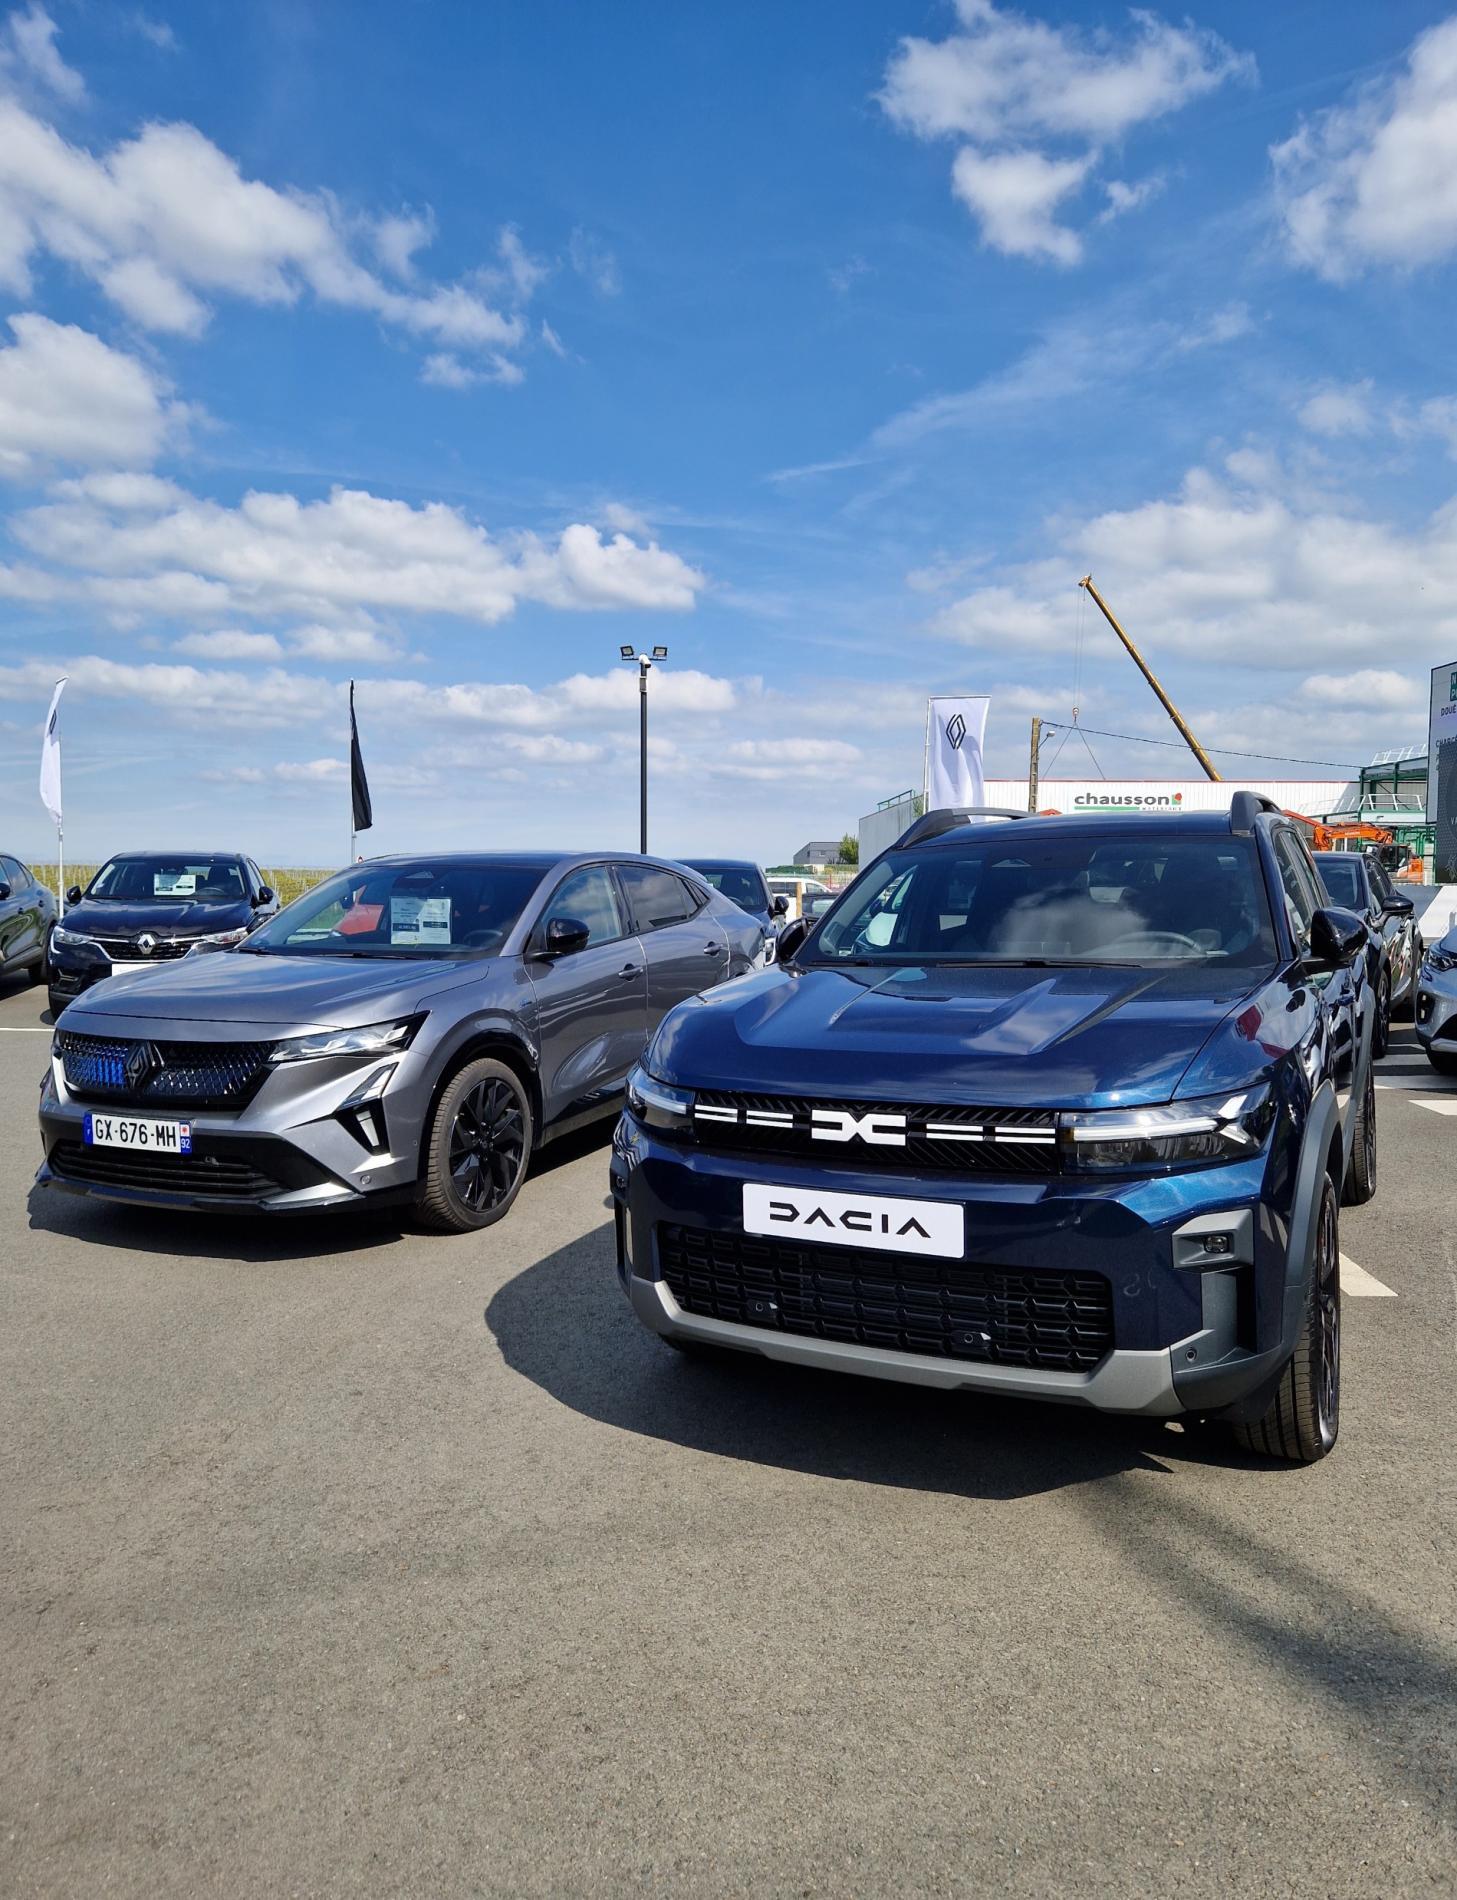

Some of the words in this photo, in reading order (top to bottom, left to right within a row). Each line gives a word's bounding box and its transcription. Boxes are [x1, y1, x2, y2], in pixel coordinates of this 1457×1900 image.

[1074, 792, 1170, 806] chausson
[95, 1118, 177, 1148] GX-676-MH
[181, 1138, 191, 1149] 92
[769, 1200, 932, 1239] DACIA
